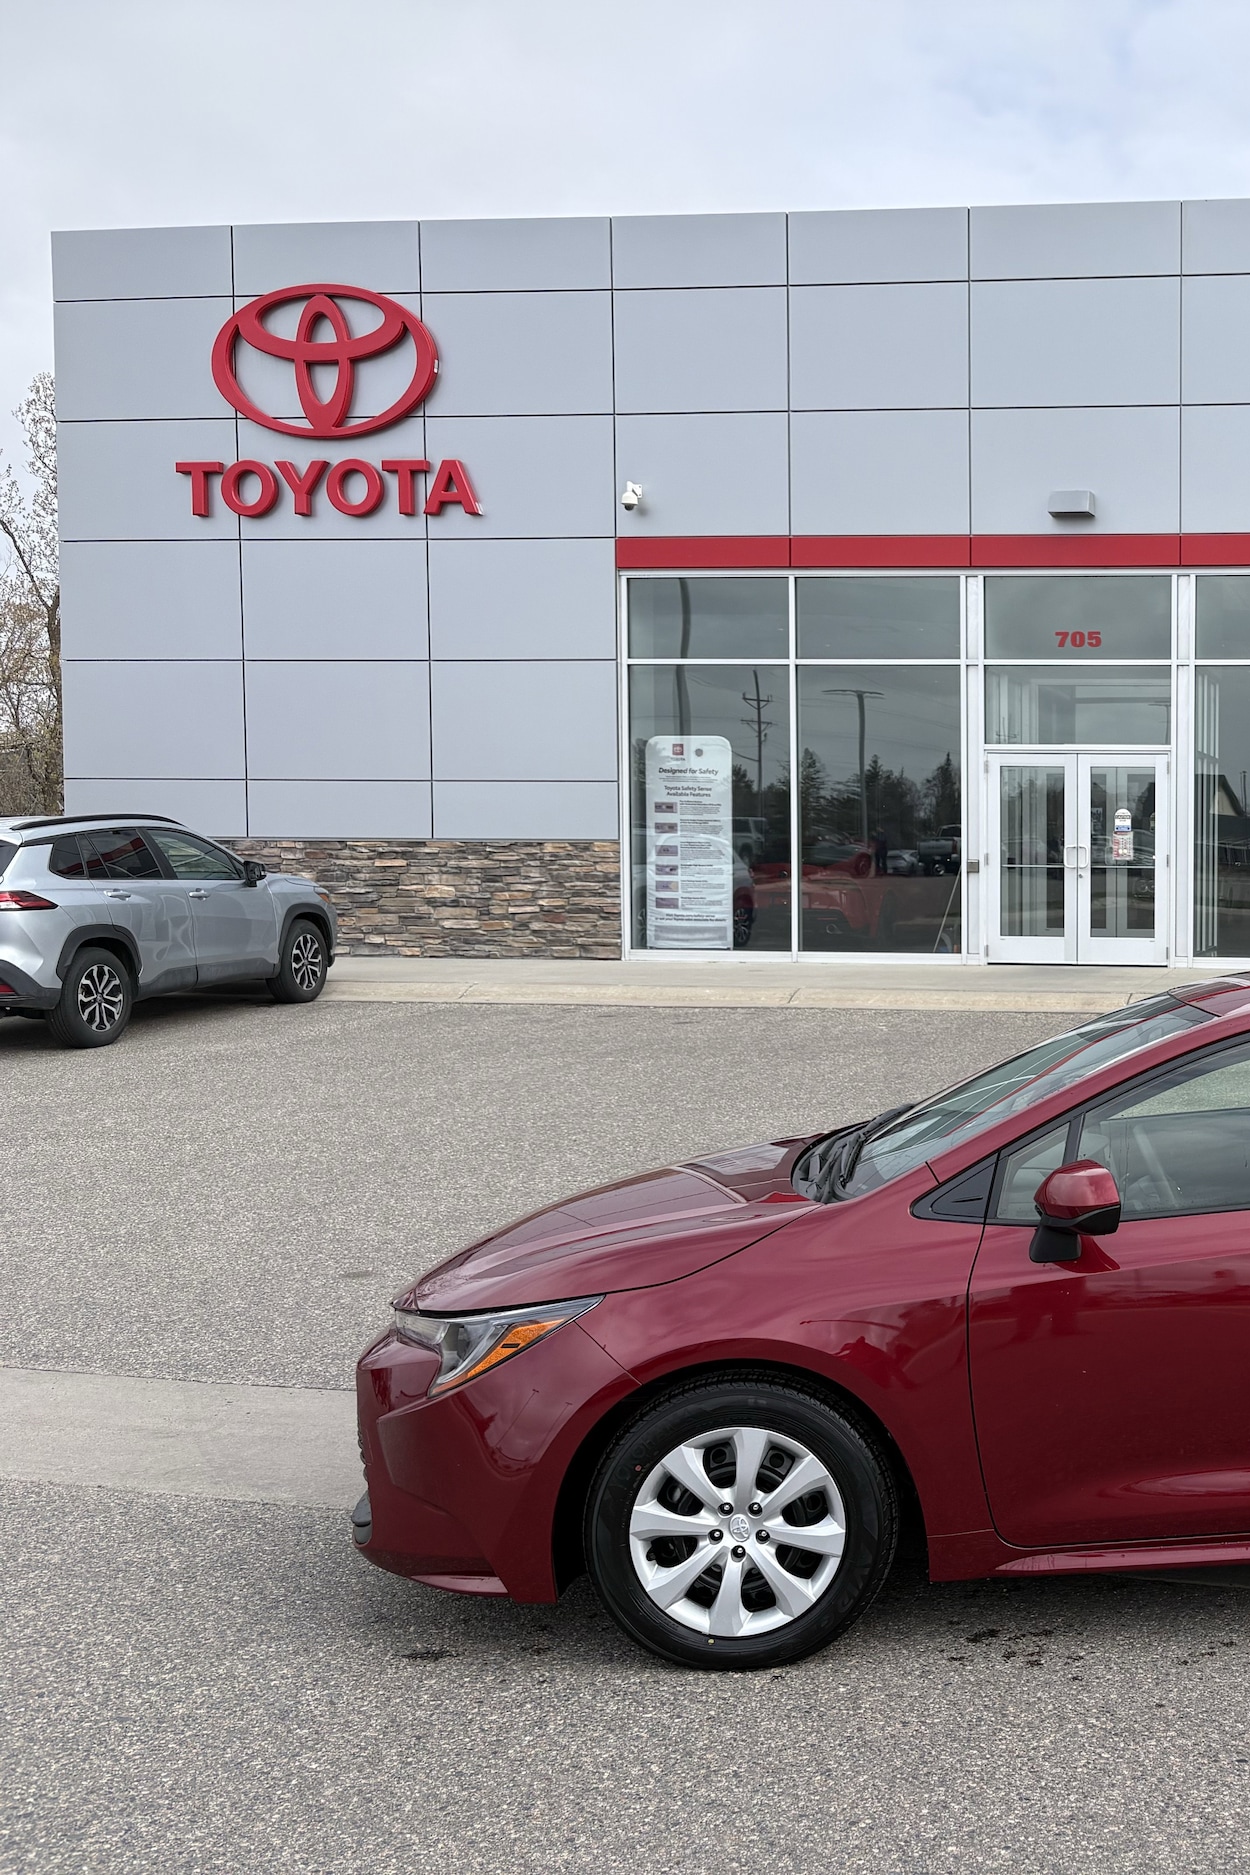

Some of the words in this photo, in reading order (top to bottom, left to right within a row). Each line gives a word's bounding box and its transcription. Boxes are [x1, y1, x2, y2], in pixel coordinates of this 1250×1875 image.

[175, 459, 485, 518] TOYOTA
[1054, 630, 1102, 648] 705
[658, 767, 688, 775] Designed
[698, 768, 719, 776] Safety
